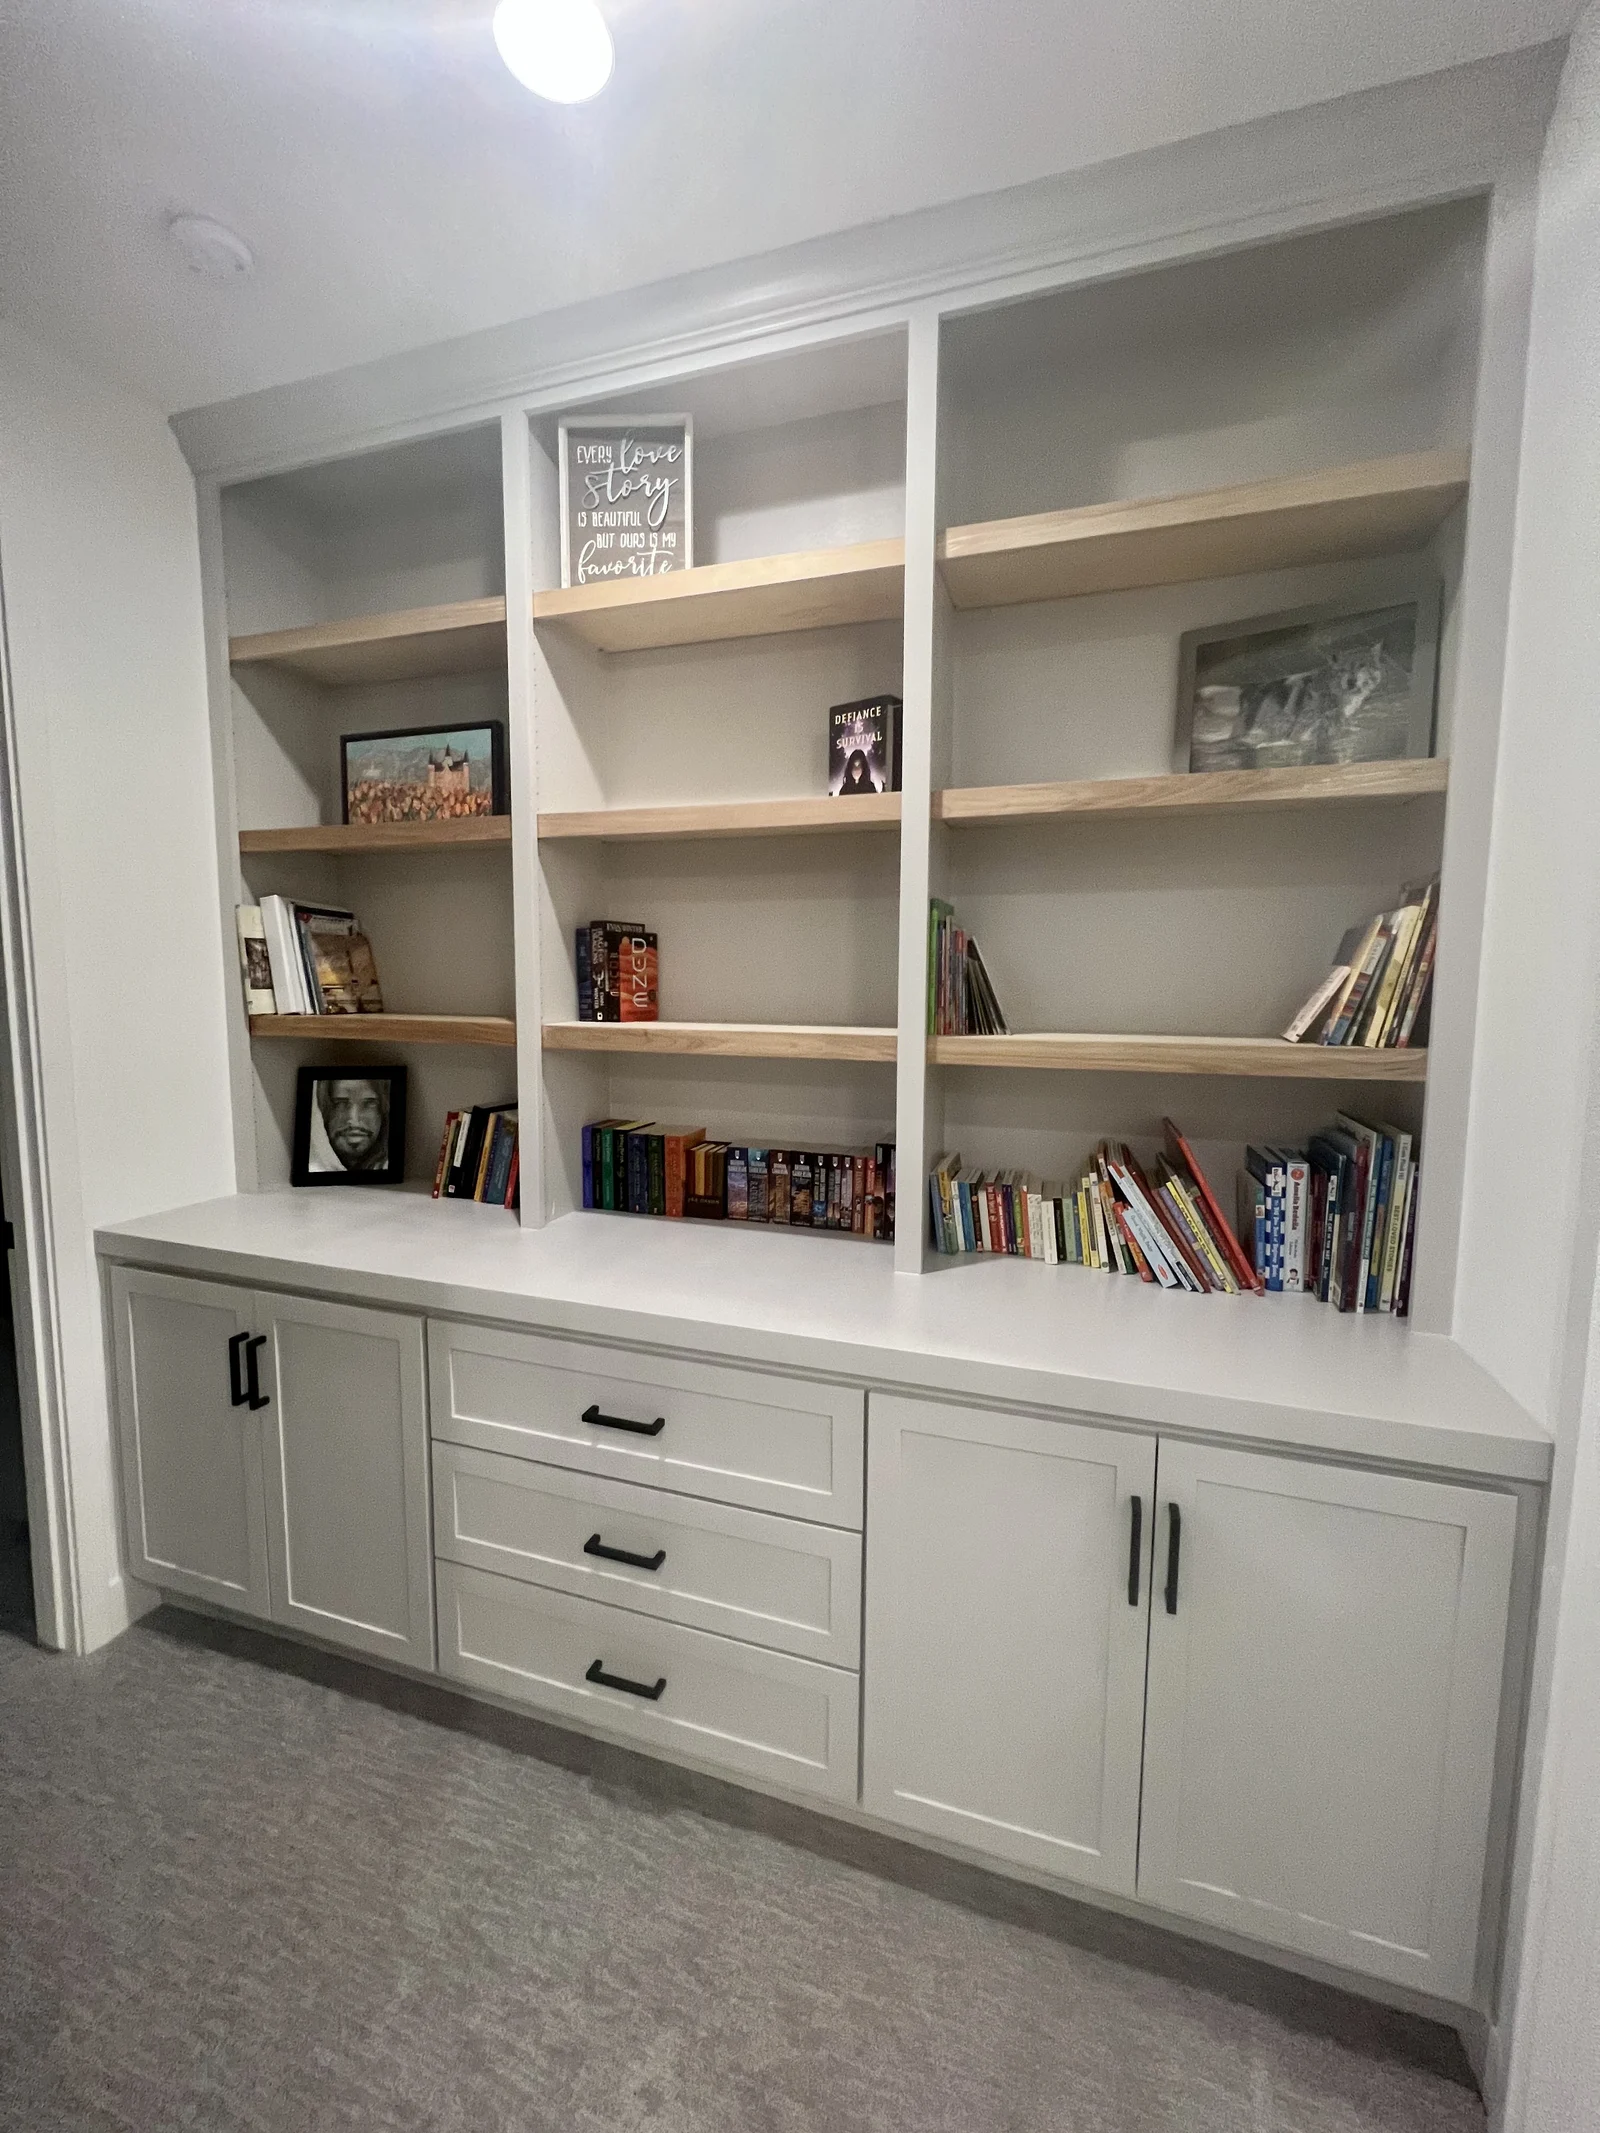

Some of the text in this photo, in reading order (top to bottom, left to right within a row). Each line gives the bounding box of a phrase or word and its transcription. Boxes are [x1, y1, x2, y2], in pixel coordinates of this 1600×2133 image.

[577, 431, 683, 474] EVERY love
[582, 461, 679, 527] story
[578, 511, 642, 527] IS BEAUTIFUL
[596, 532, 677, 549] BUT OURS IS MY
[577, 539, 674, 584] favorite
[835, 706, 882, 725] DEFIANCE
[854, 722, 864, 733] IS
[836, 731, 883, 750] SURVIVAL
[1386, 1205, 1400, 1272] BEST-LOVED STORIES
